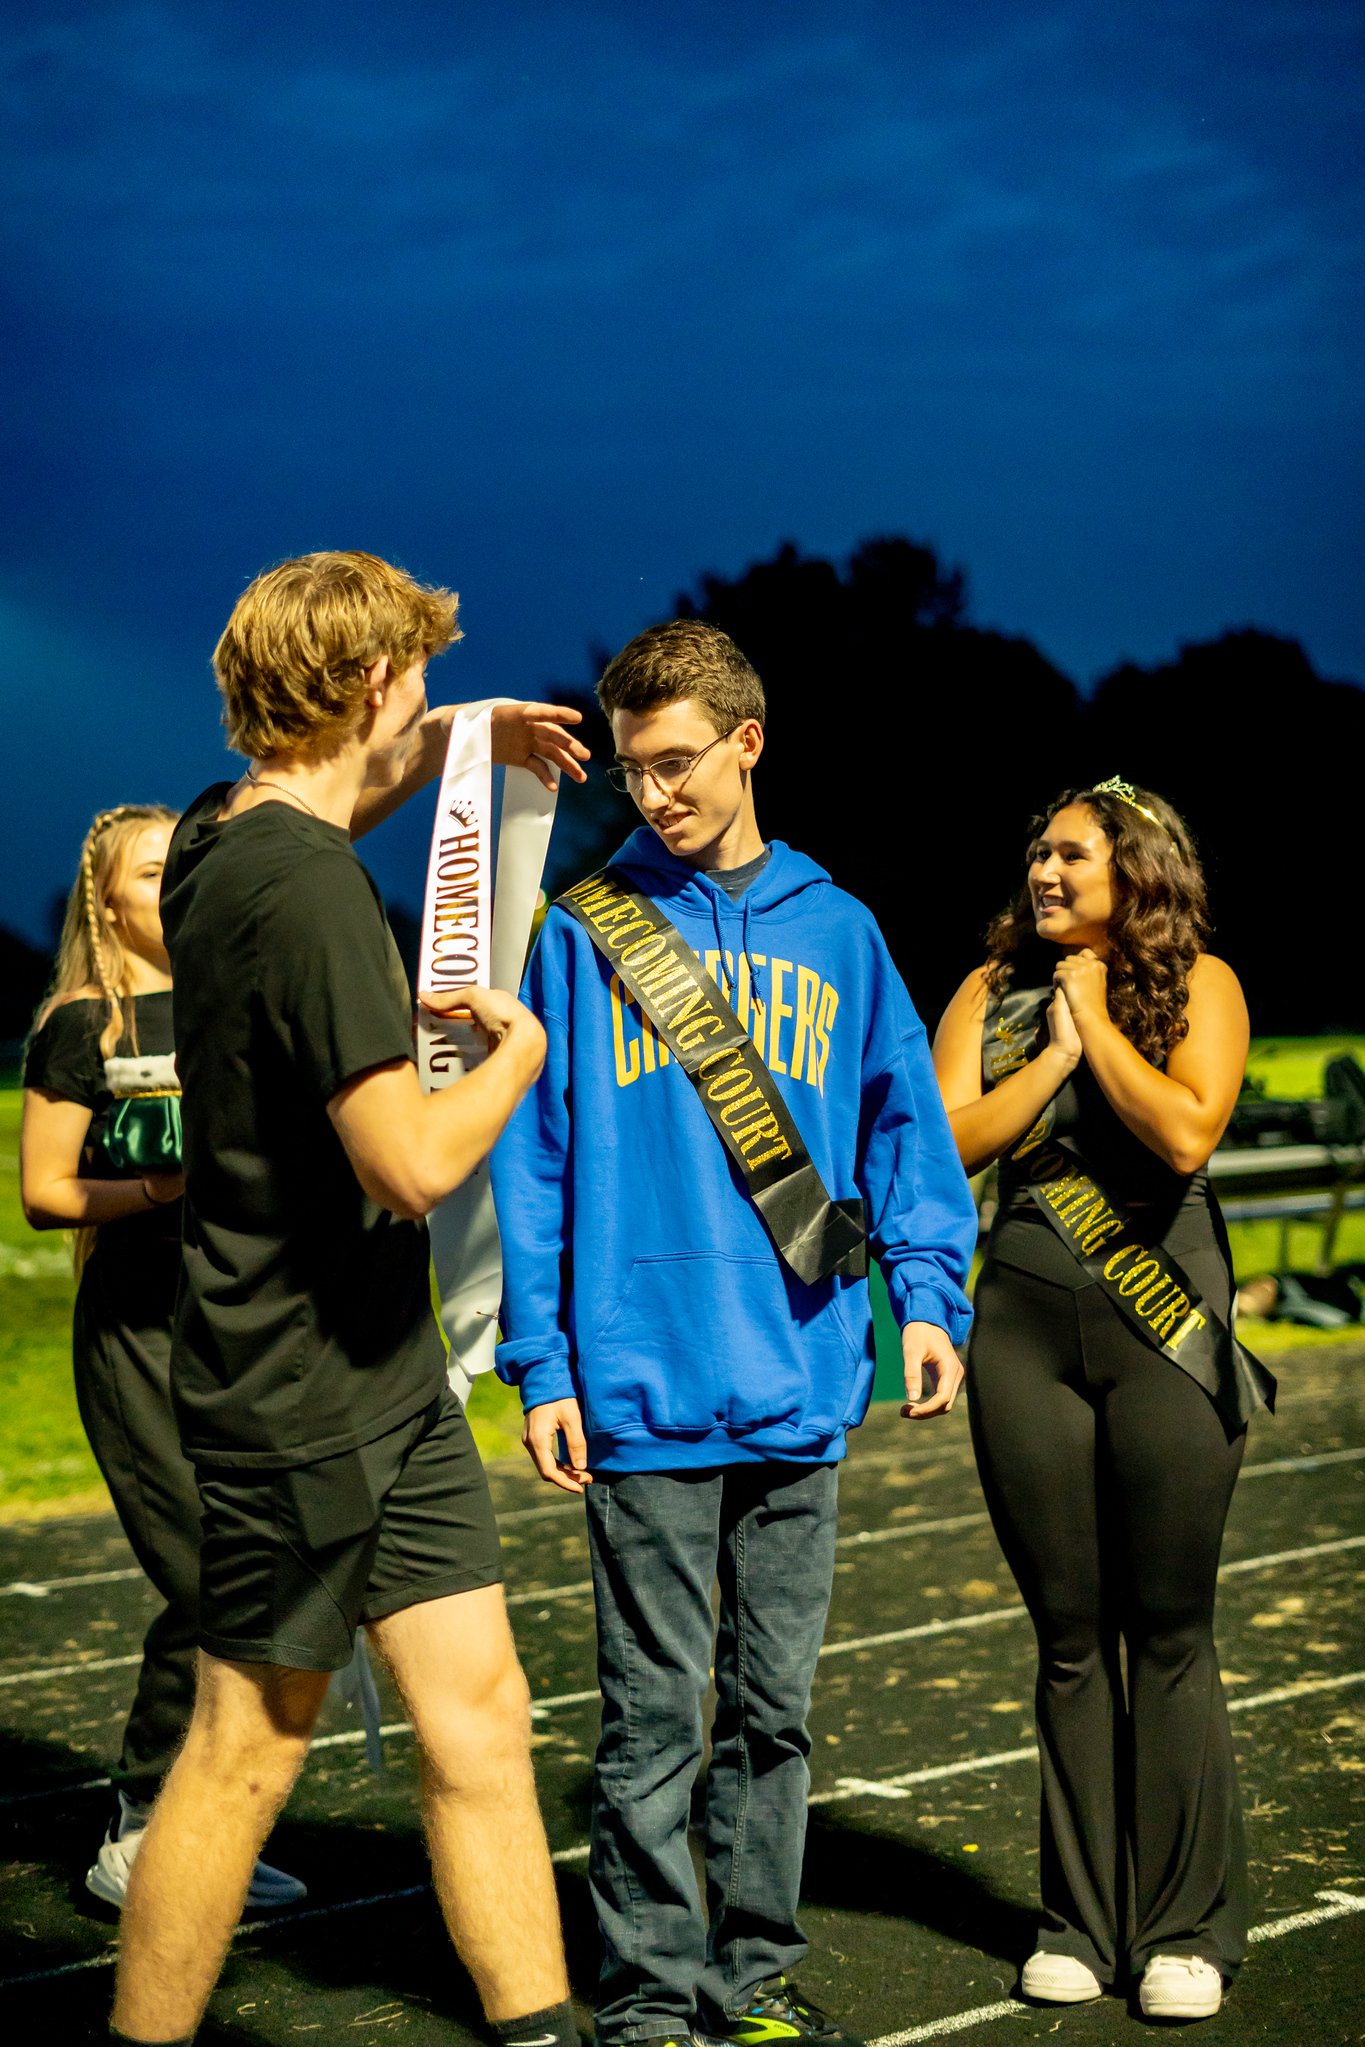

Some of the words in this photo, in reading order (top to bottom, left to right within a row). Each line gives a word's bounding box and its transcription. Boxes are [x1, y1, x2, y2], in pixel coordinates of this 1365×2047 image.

[429, 829, 480, 1074] HOMECOG
[609, 949, 840, 1100] CRGERS
[699, 1046, 793, 1172] COURT
[1103, 1243, 1207, 1351] COURT
